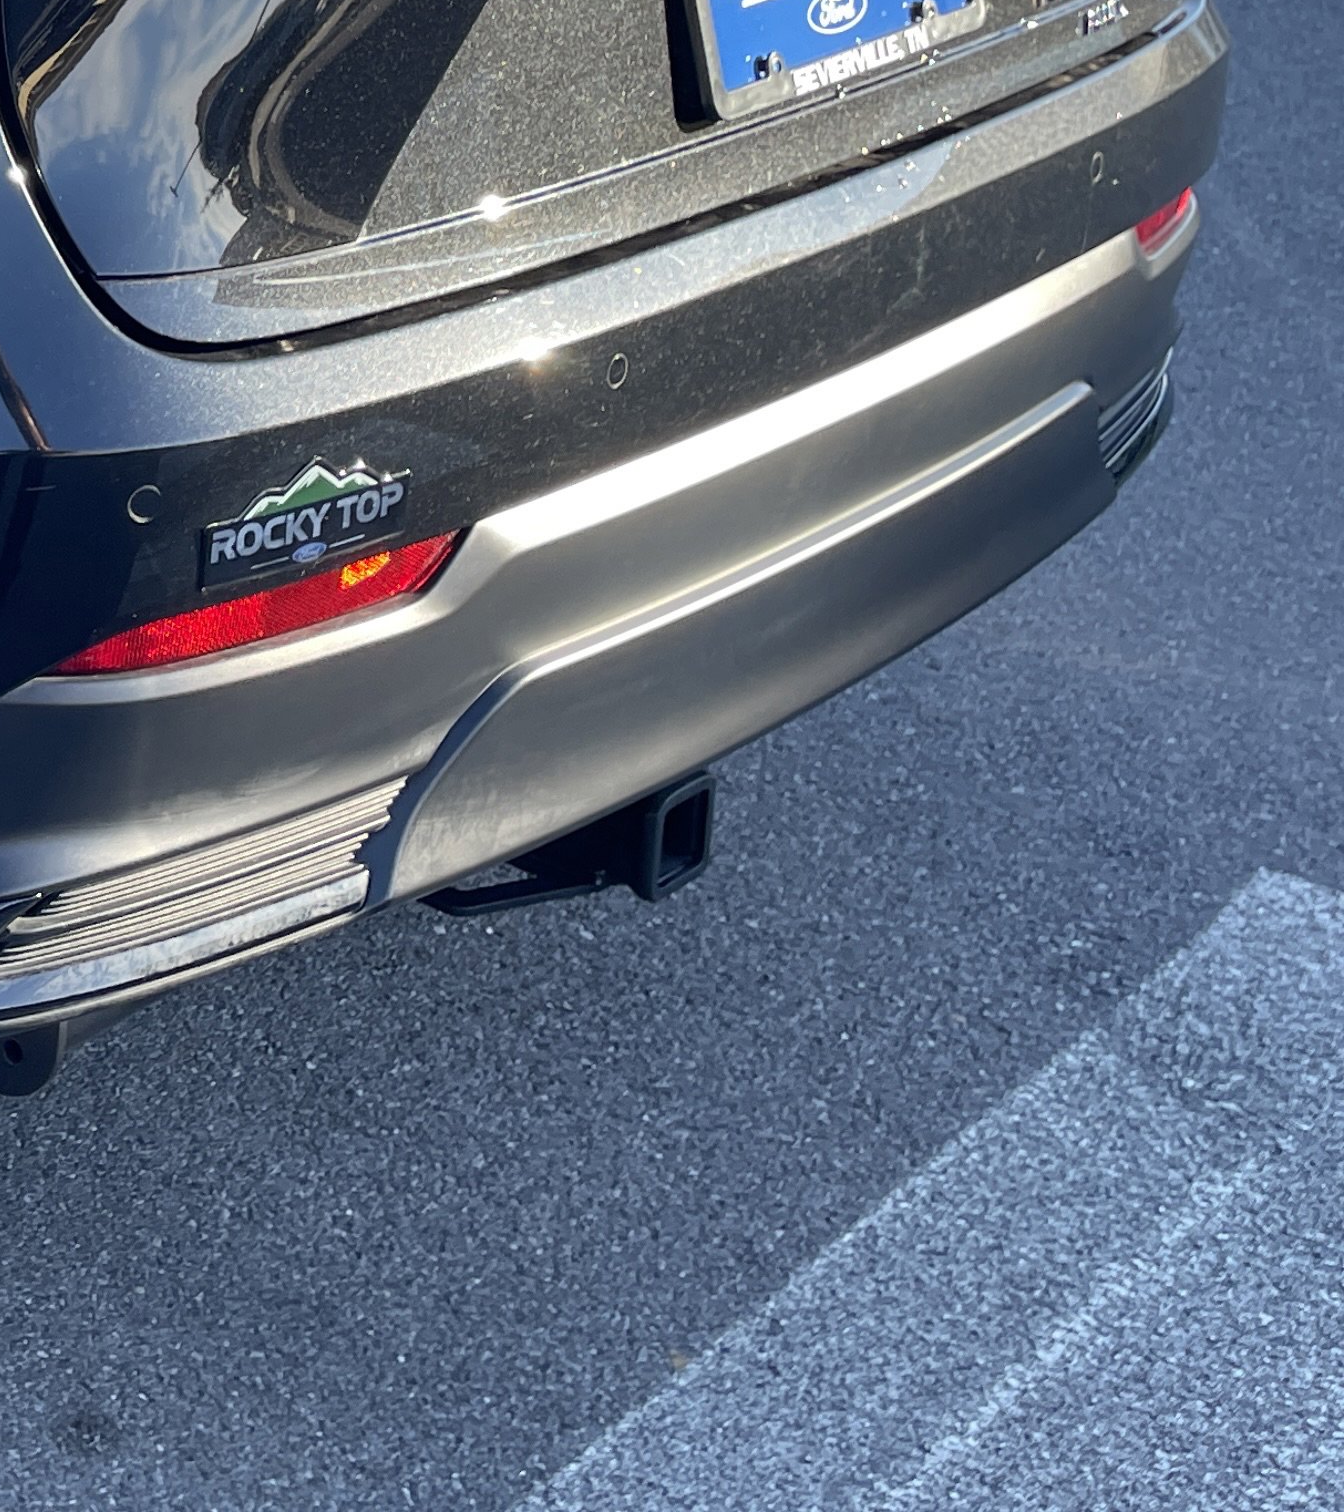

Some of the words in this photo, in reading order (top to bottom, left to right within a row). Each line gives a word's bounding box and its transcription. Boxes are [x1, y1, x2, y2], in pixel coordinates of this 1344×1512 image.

[903, 24, 930, 54] TN
[210, 501, 335, 564] ROCKY
[336, 482, 405, 529] TOP
